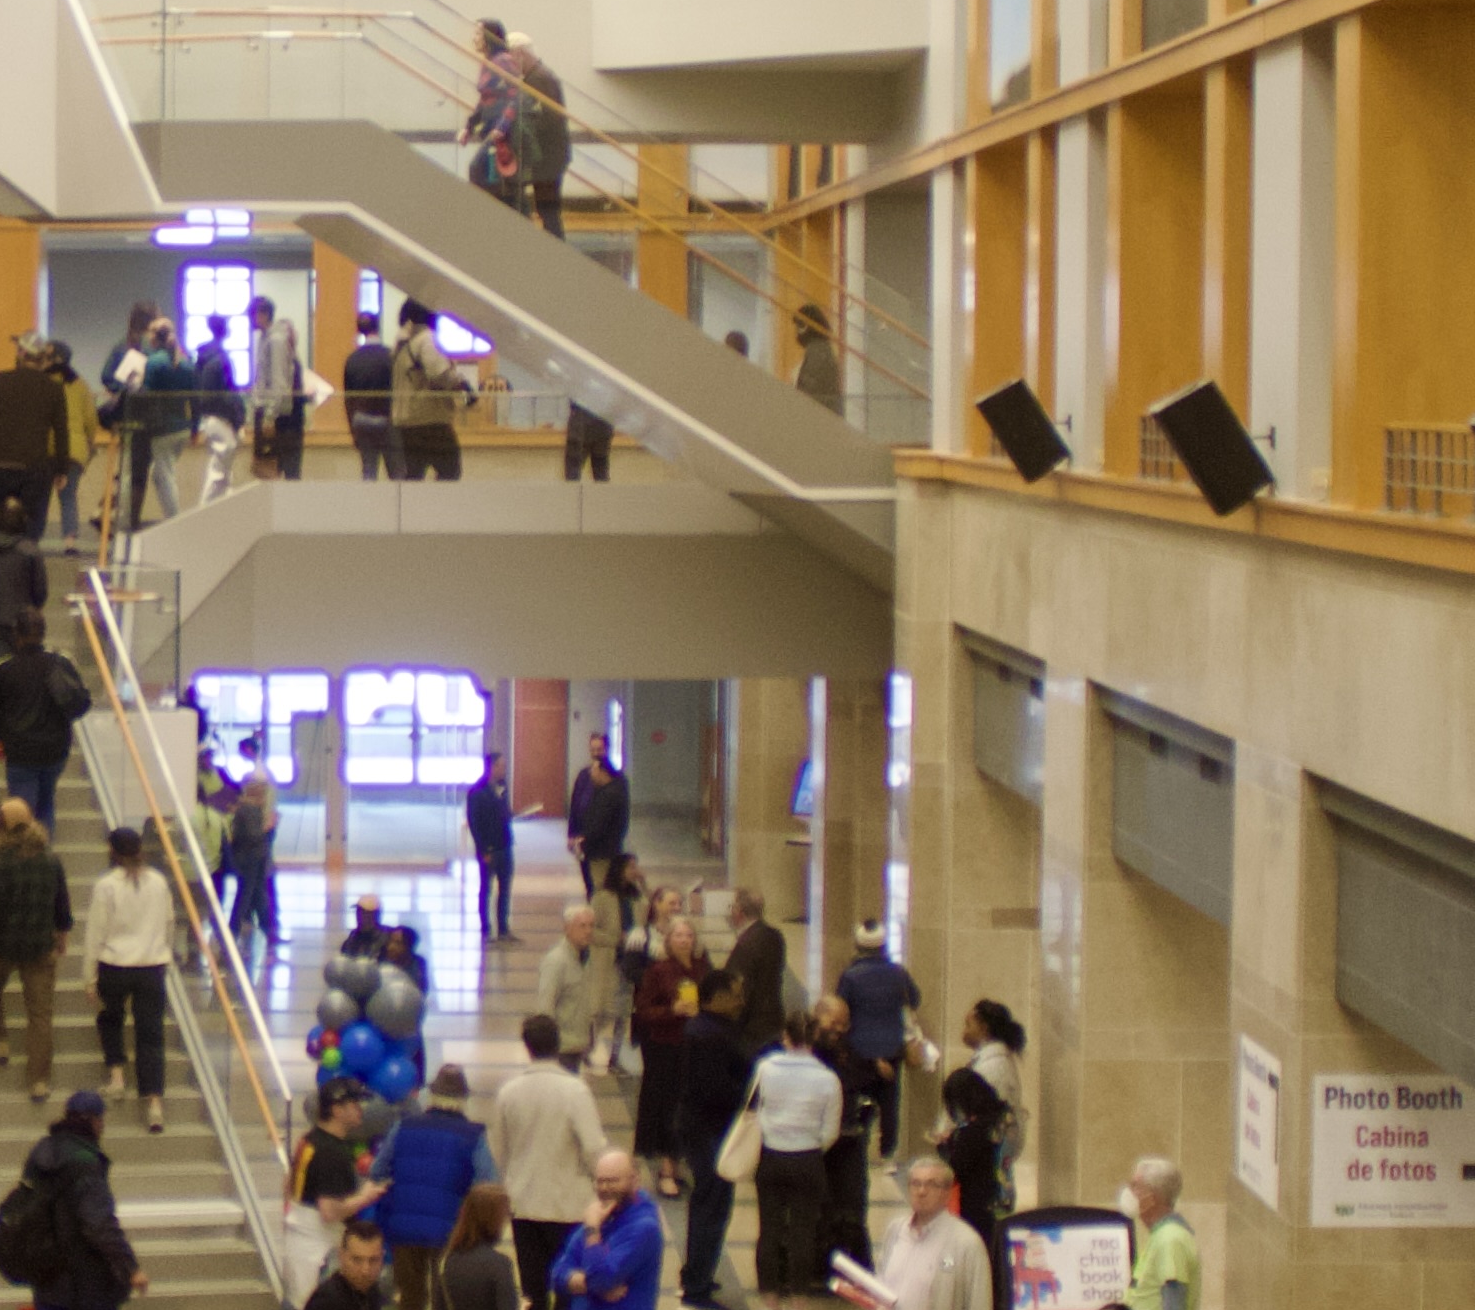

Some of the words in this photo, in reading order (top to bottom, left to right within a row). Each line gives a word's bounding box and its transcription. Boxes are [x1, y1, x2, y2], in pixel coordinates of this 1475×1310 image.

[1324, 1086, 1390, 1109] Photo
[1396, 1086, 1463, 1110] Booth
[1356, 1125, 1429, 1148] Cabina
[1347, 1159, 1373, 1181] de
[1379, 1158, 1437, 1181] fotos
[1080, 1252, 1120, 1267] chair
[1080, 1270, 1122, 1284] book
[1082, 1287, 1124, 1303] shop
